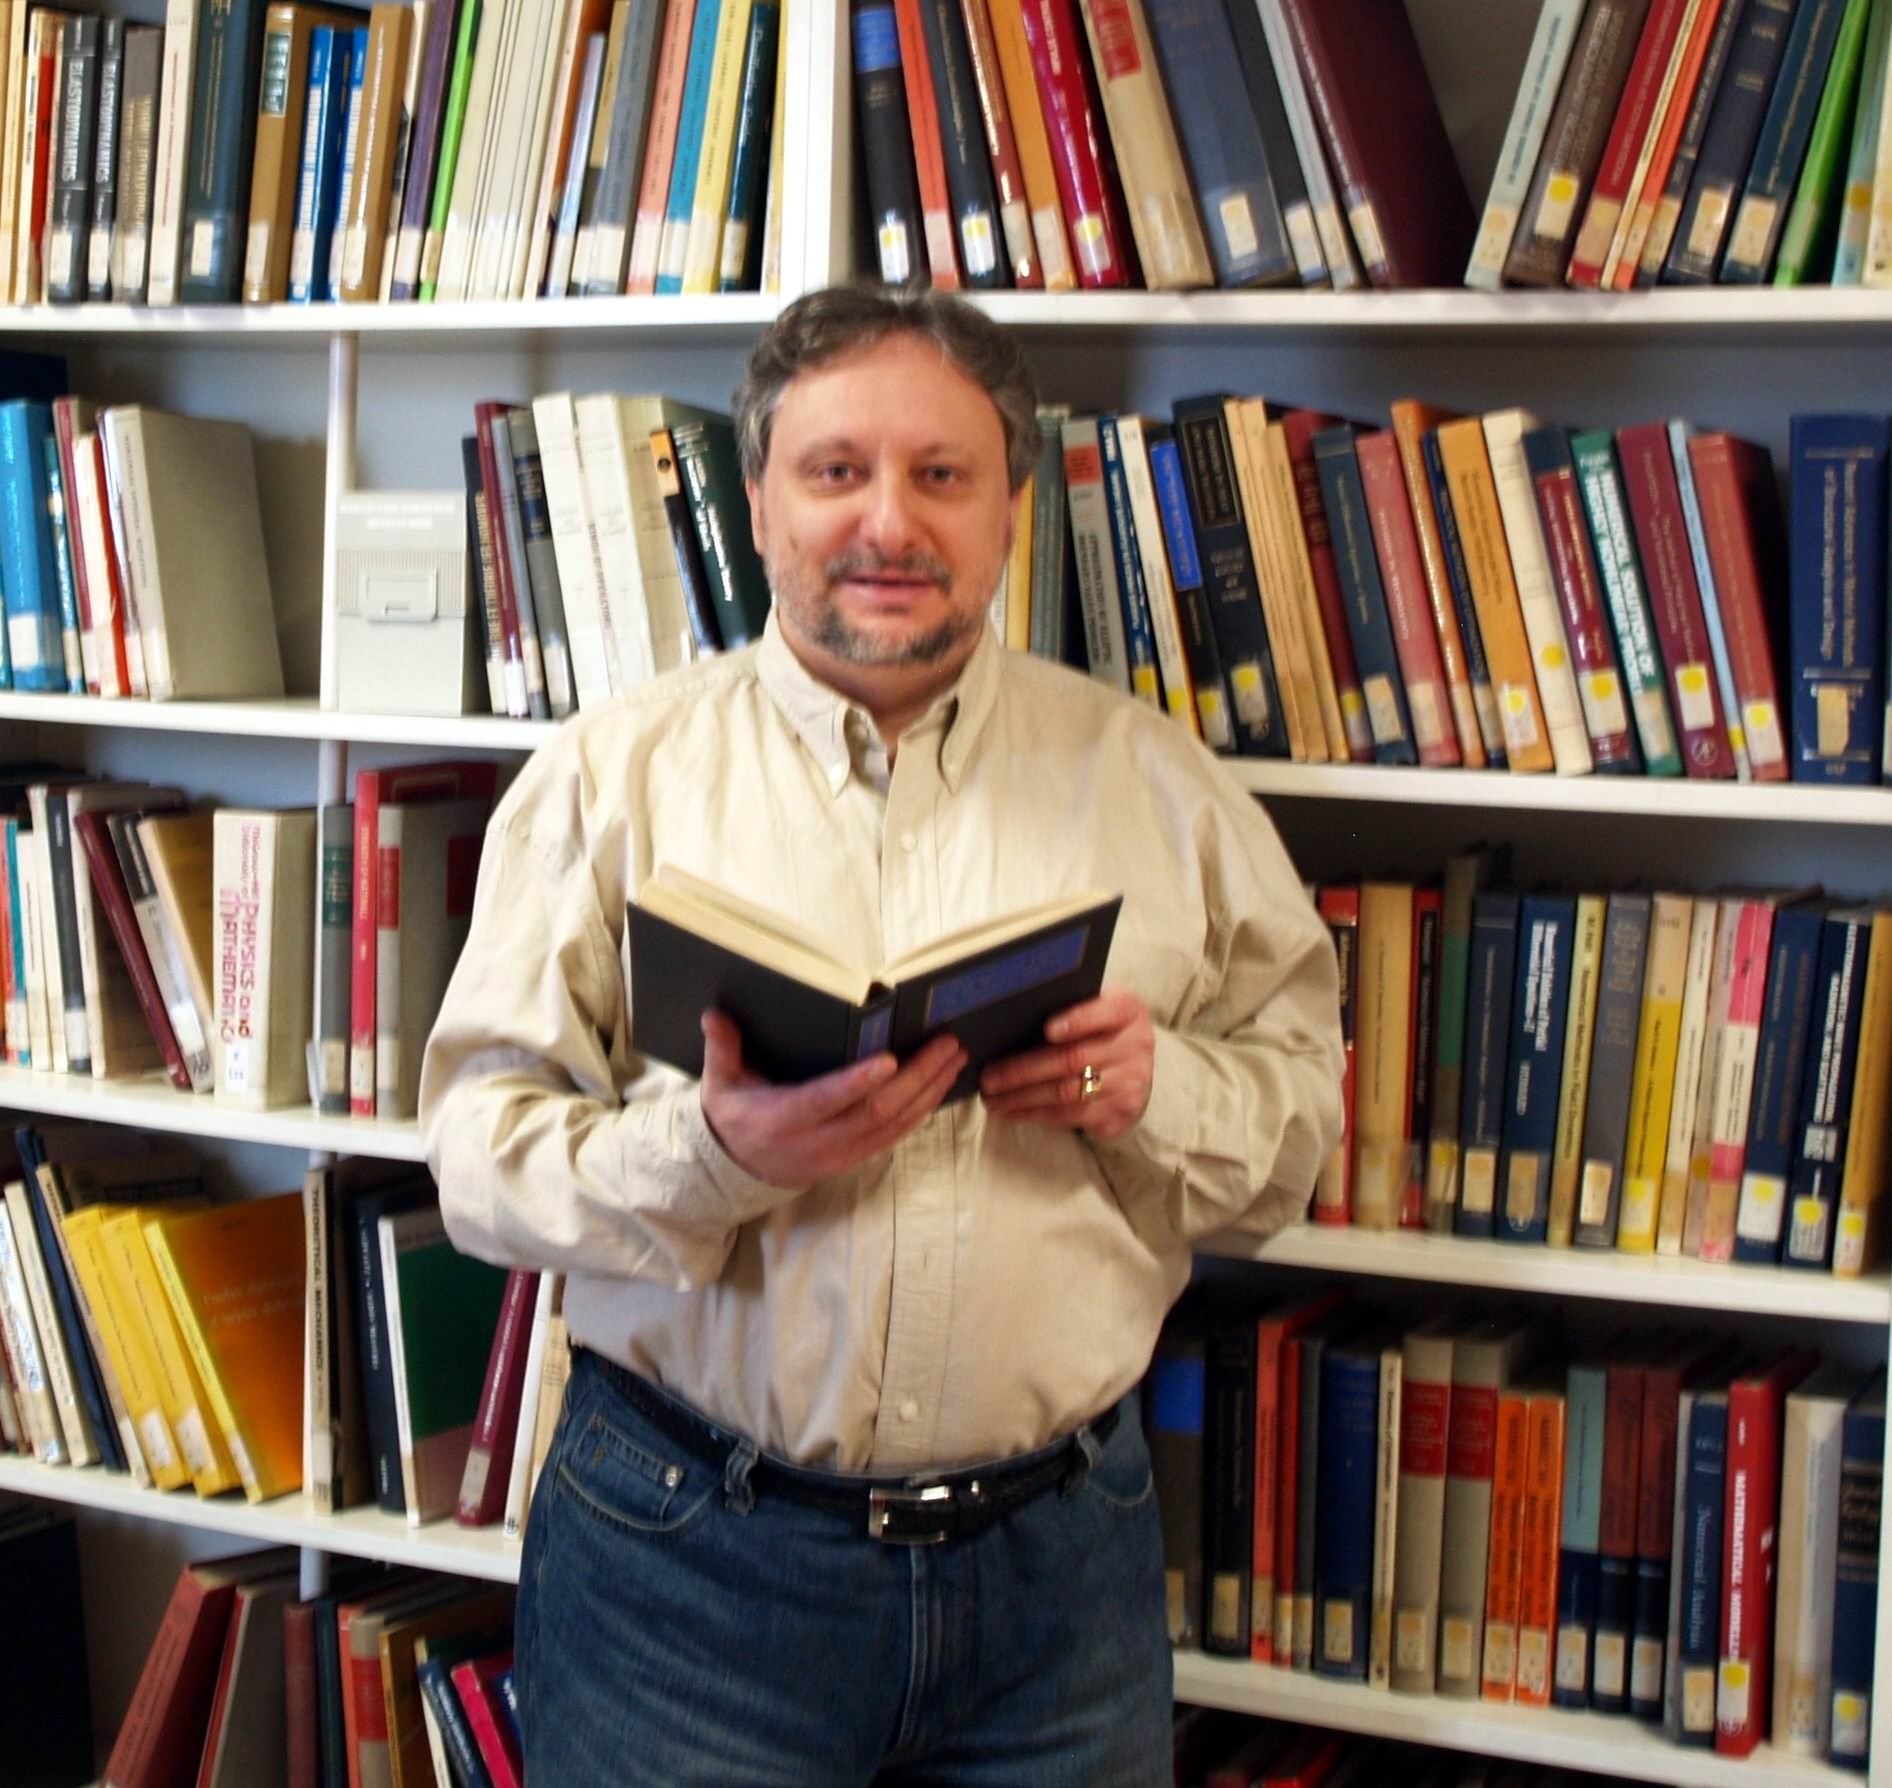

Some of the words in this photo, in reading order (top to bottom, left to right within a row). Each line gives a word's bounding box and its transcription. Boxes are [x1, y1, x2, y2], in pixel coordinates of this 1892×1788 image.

[62, 58, 84, 181] ELASTODYNAMICS
[220, 887, 241, 1043] MATHEMATIC
[239, 901, 259, 990] PHYSICS
[314, 1289, 324, 1369] MECHANICS
[1731, 1470, 1746, 1584] MATHEMATICAL
